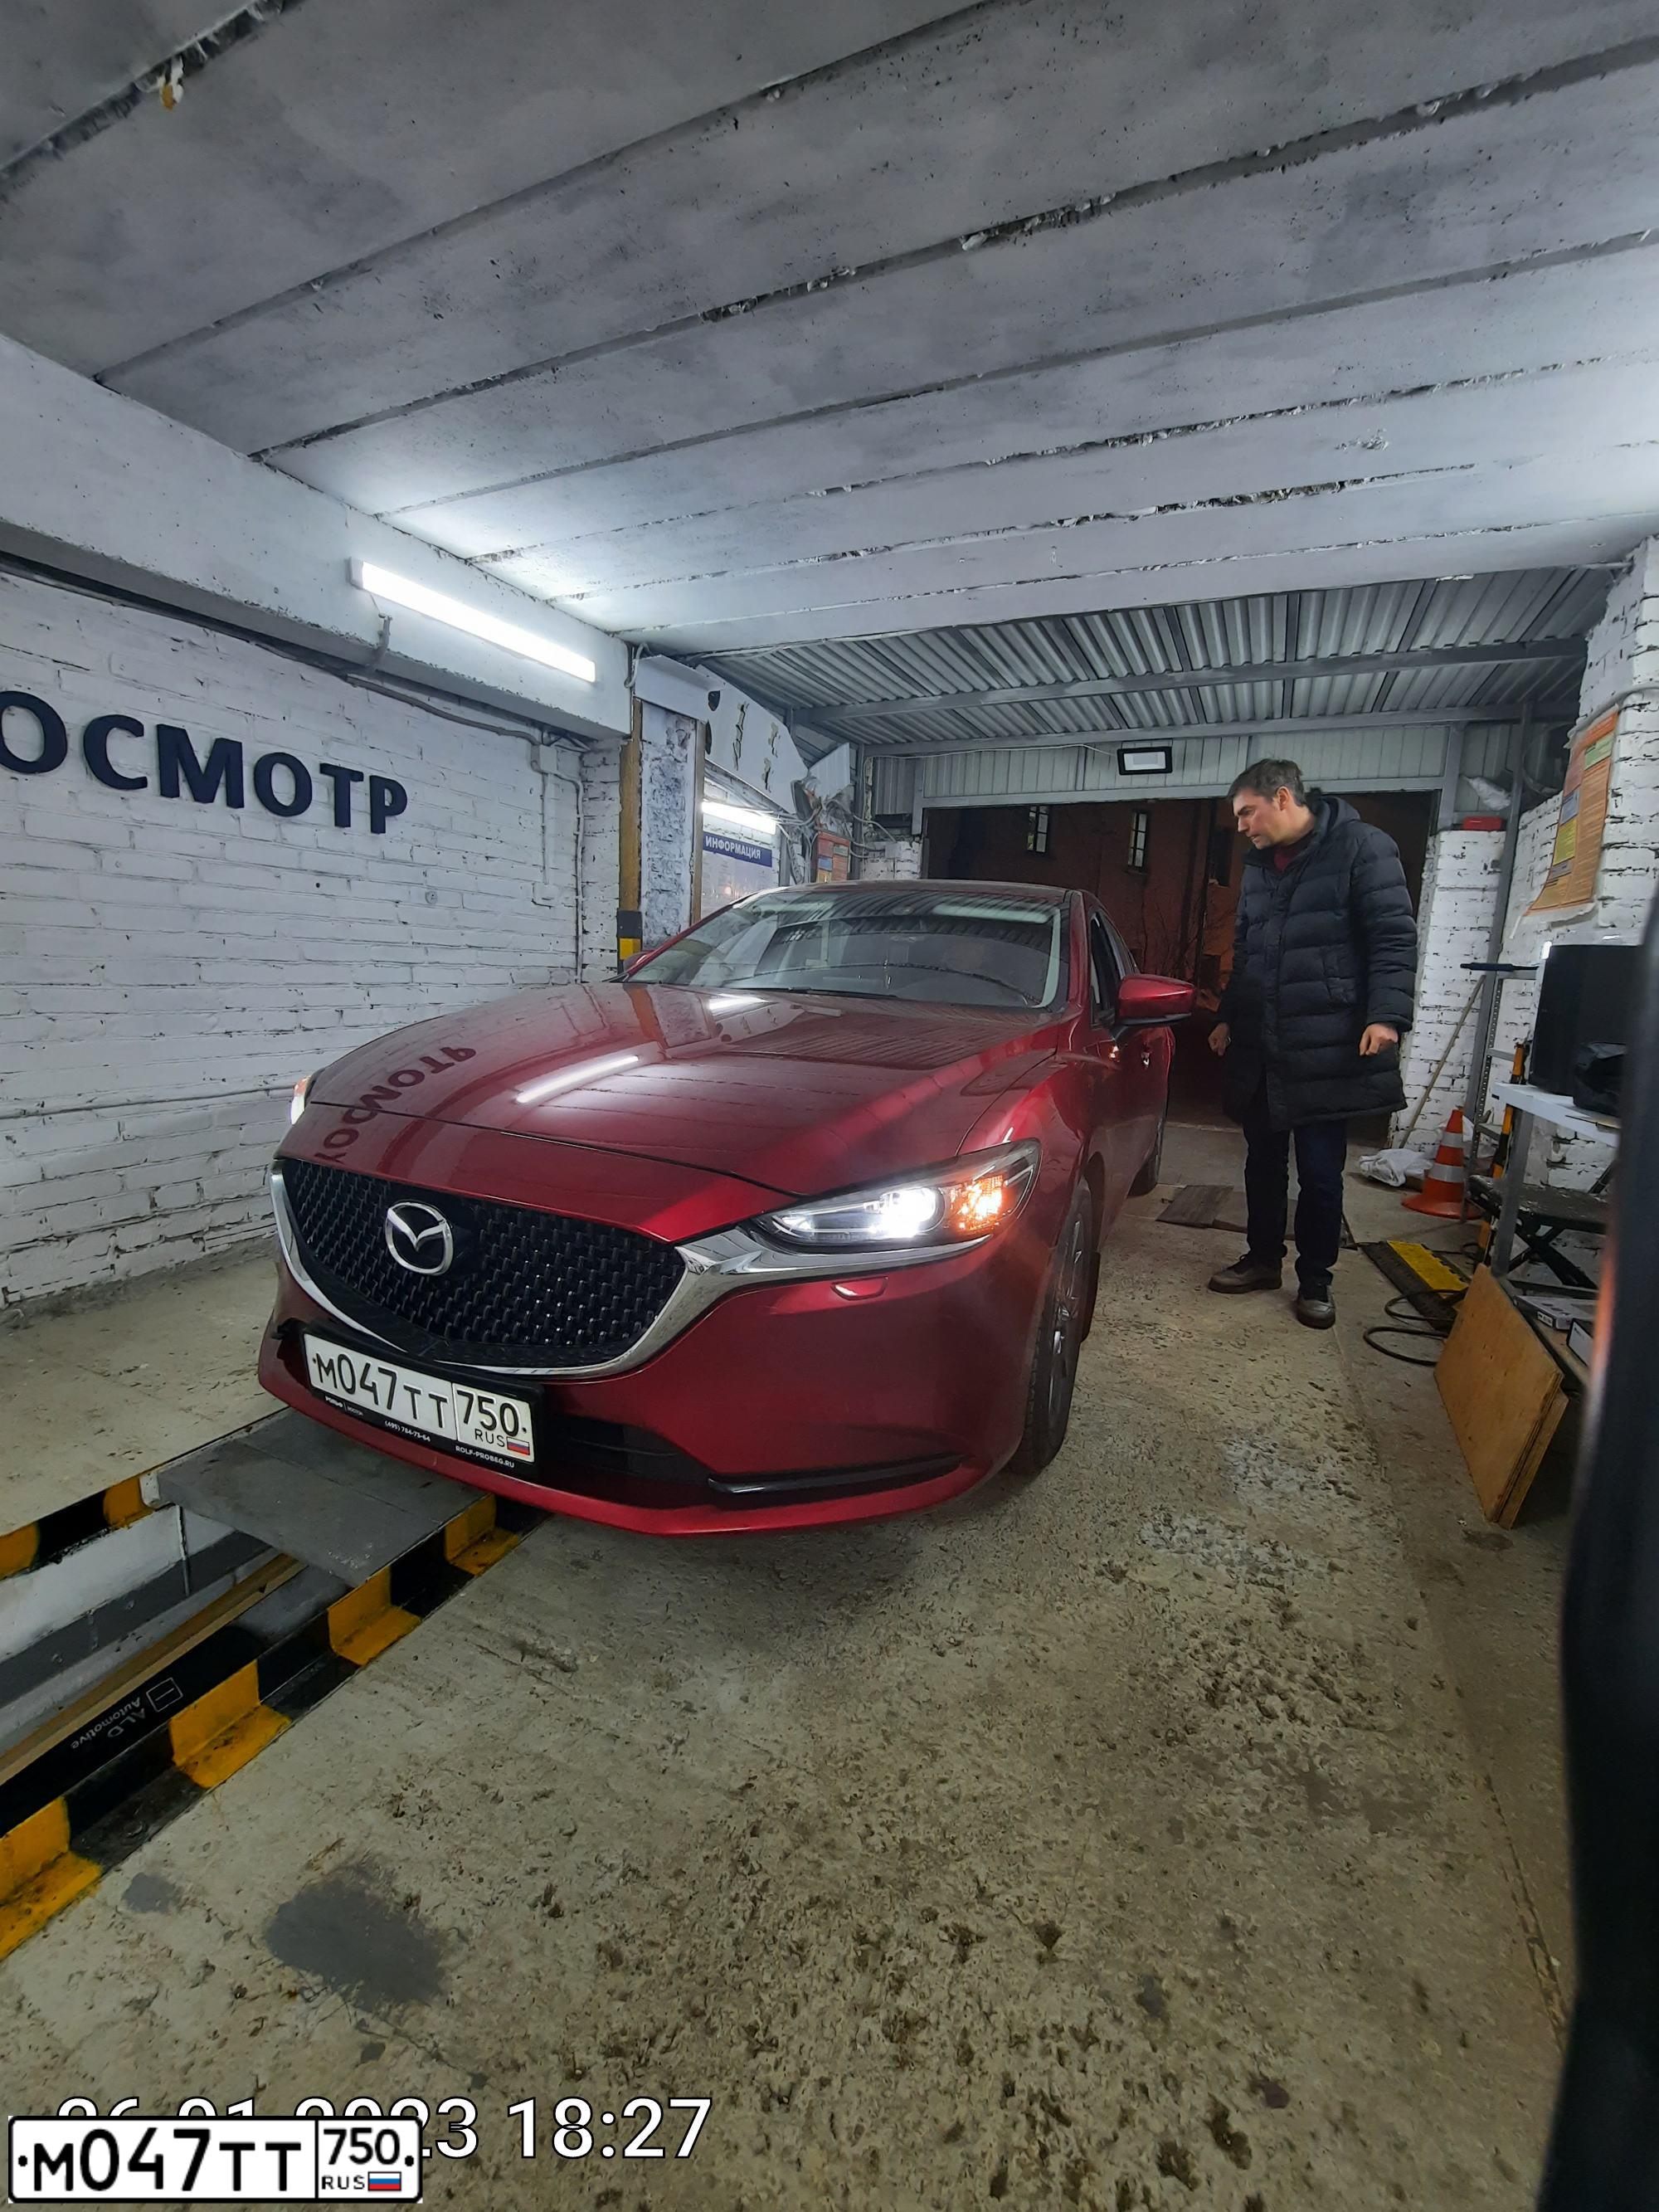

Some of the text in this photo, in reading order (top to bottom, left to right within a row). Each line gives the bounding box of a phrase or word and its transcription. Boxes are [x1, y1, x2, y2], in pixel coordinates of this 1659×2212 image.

[0, 690, 408, 834] ОСМОТР
[705, 836, 761, 859] ИНФОРМАЦИЯ
[315, 1352, 519, 1437] М047ТТ 750
[474, 1428, 505, 1448] RUS
[455, 1445, 515, 1469] ROLF-PROBEG.RU
[71, 1696, 142, 1749] Automotive
[107, 1707, 146, 1738] ALD
